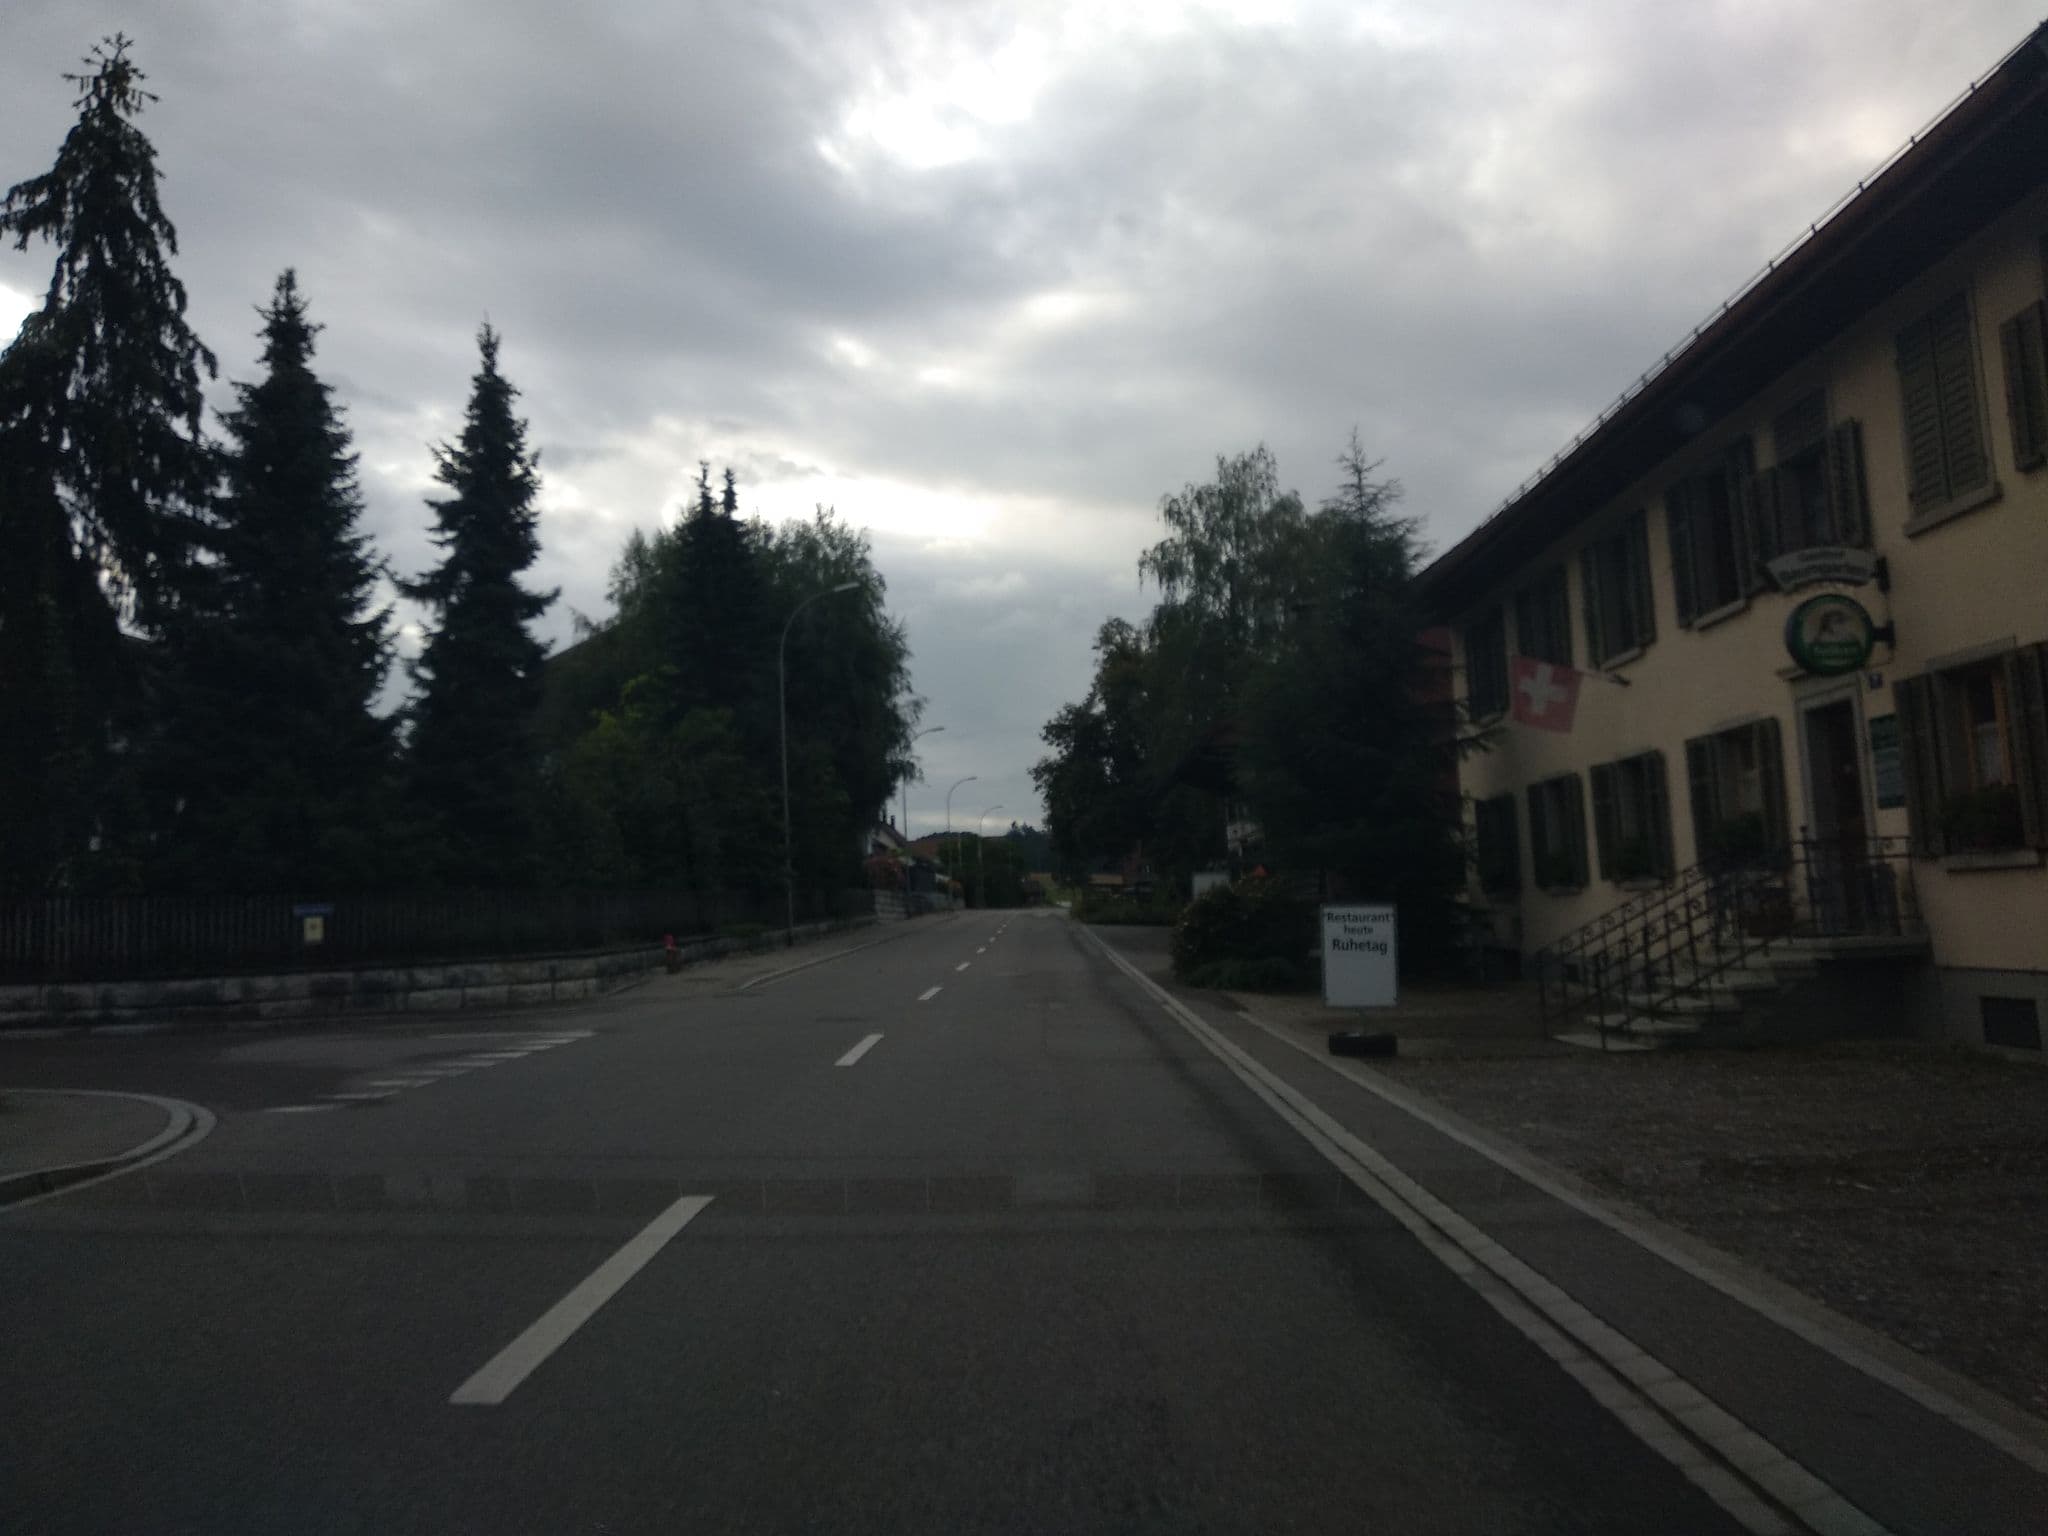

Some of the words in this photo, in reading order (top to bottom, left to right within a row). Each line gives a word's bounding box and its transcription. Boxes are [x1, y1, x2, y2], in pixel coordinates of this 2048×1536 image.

[1327, 912, 1390, 923] Restaurant
[1343, 924, 1374, 935] heute
[1332, 938, 1388, 956] Ruhetag
